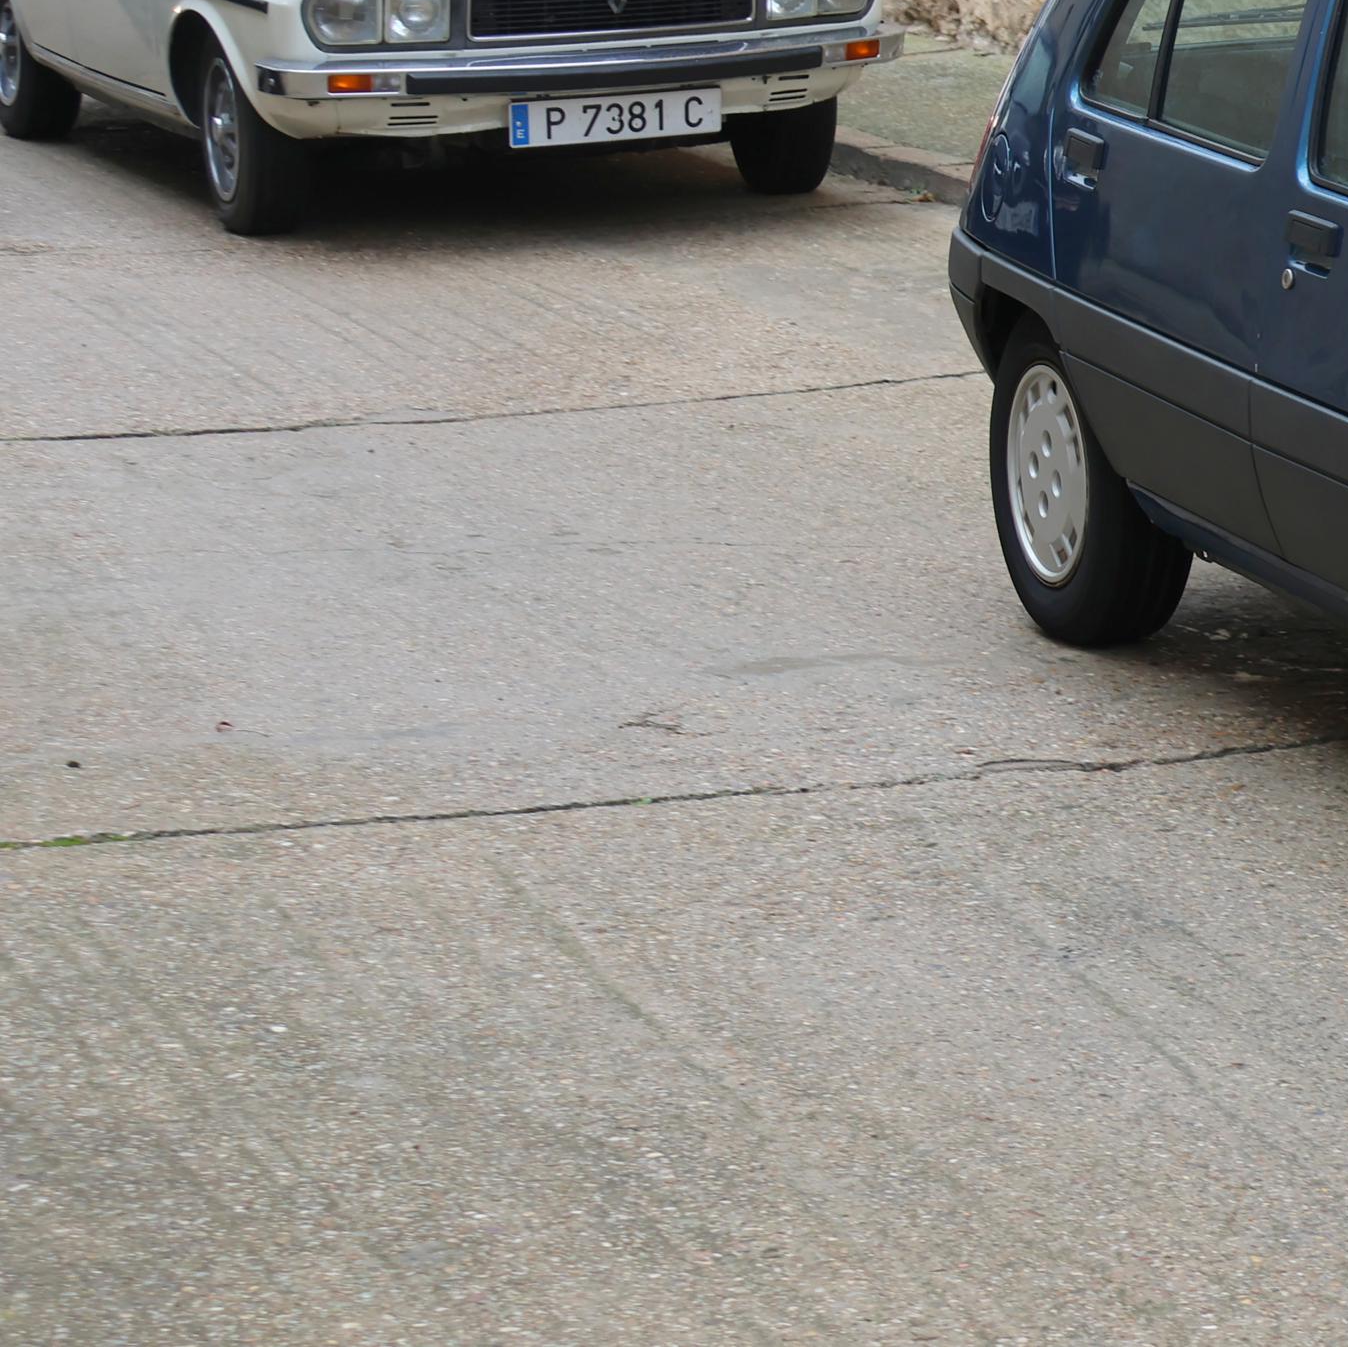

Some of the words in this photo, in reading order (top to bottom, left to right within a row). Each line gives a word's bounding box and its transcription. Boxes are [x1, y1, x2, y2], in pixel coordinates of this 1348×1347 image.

[545, 107, 566, 140] P
[582, 99, 665, 137] 7381
[684, 96, 704, 128] C
